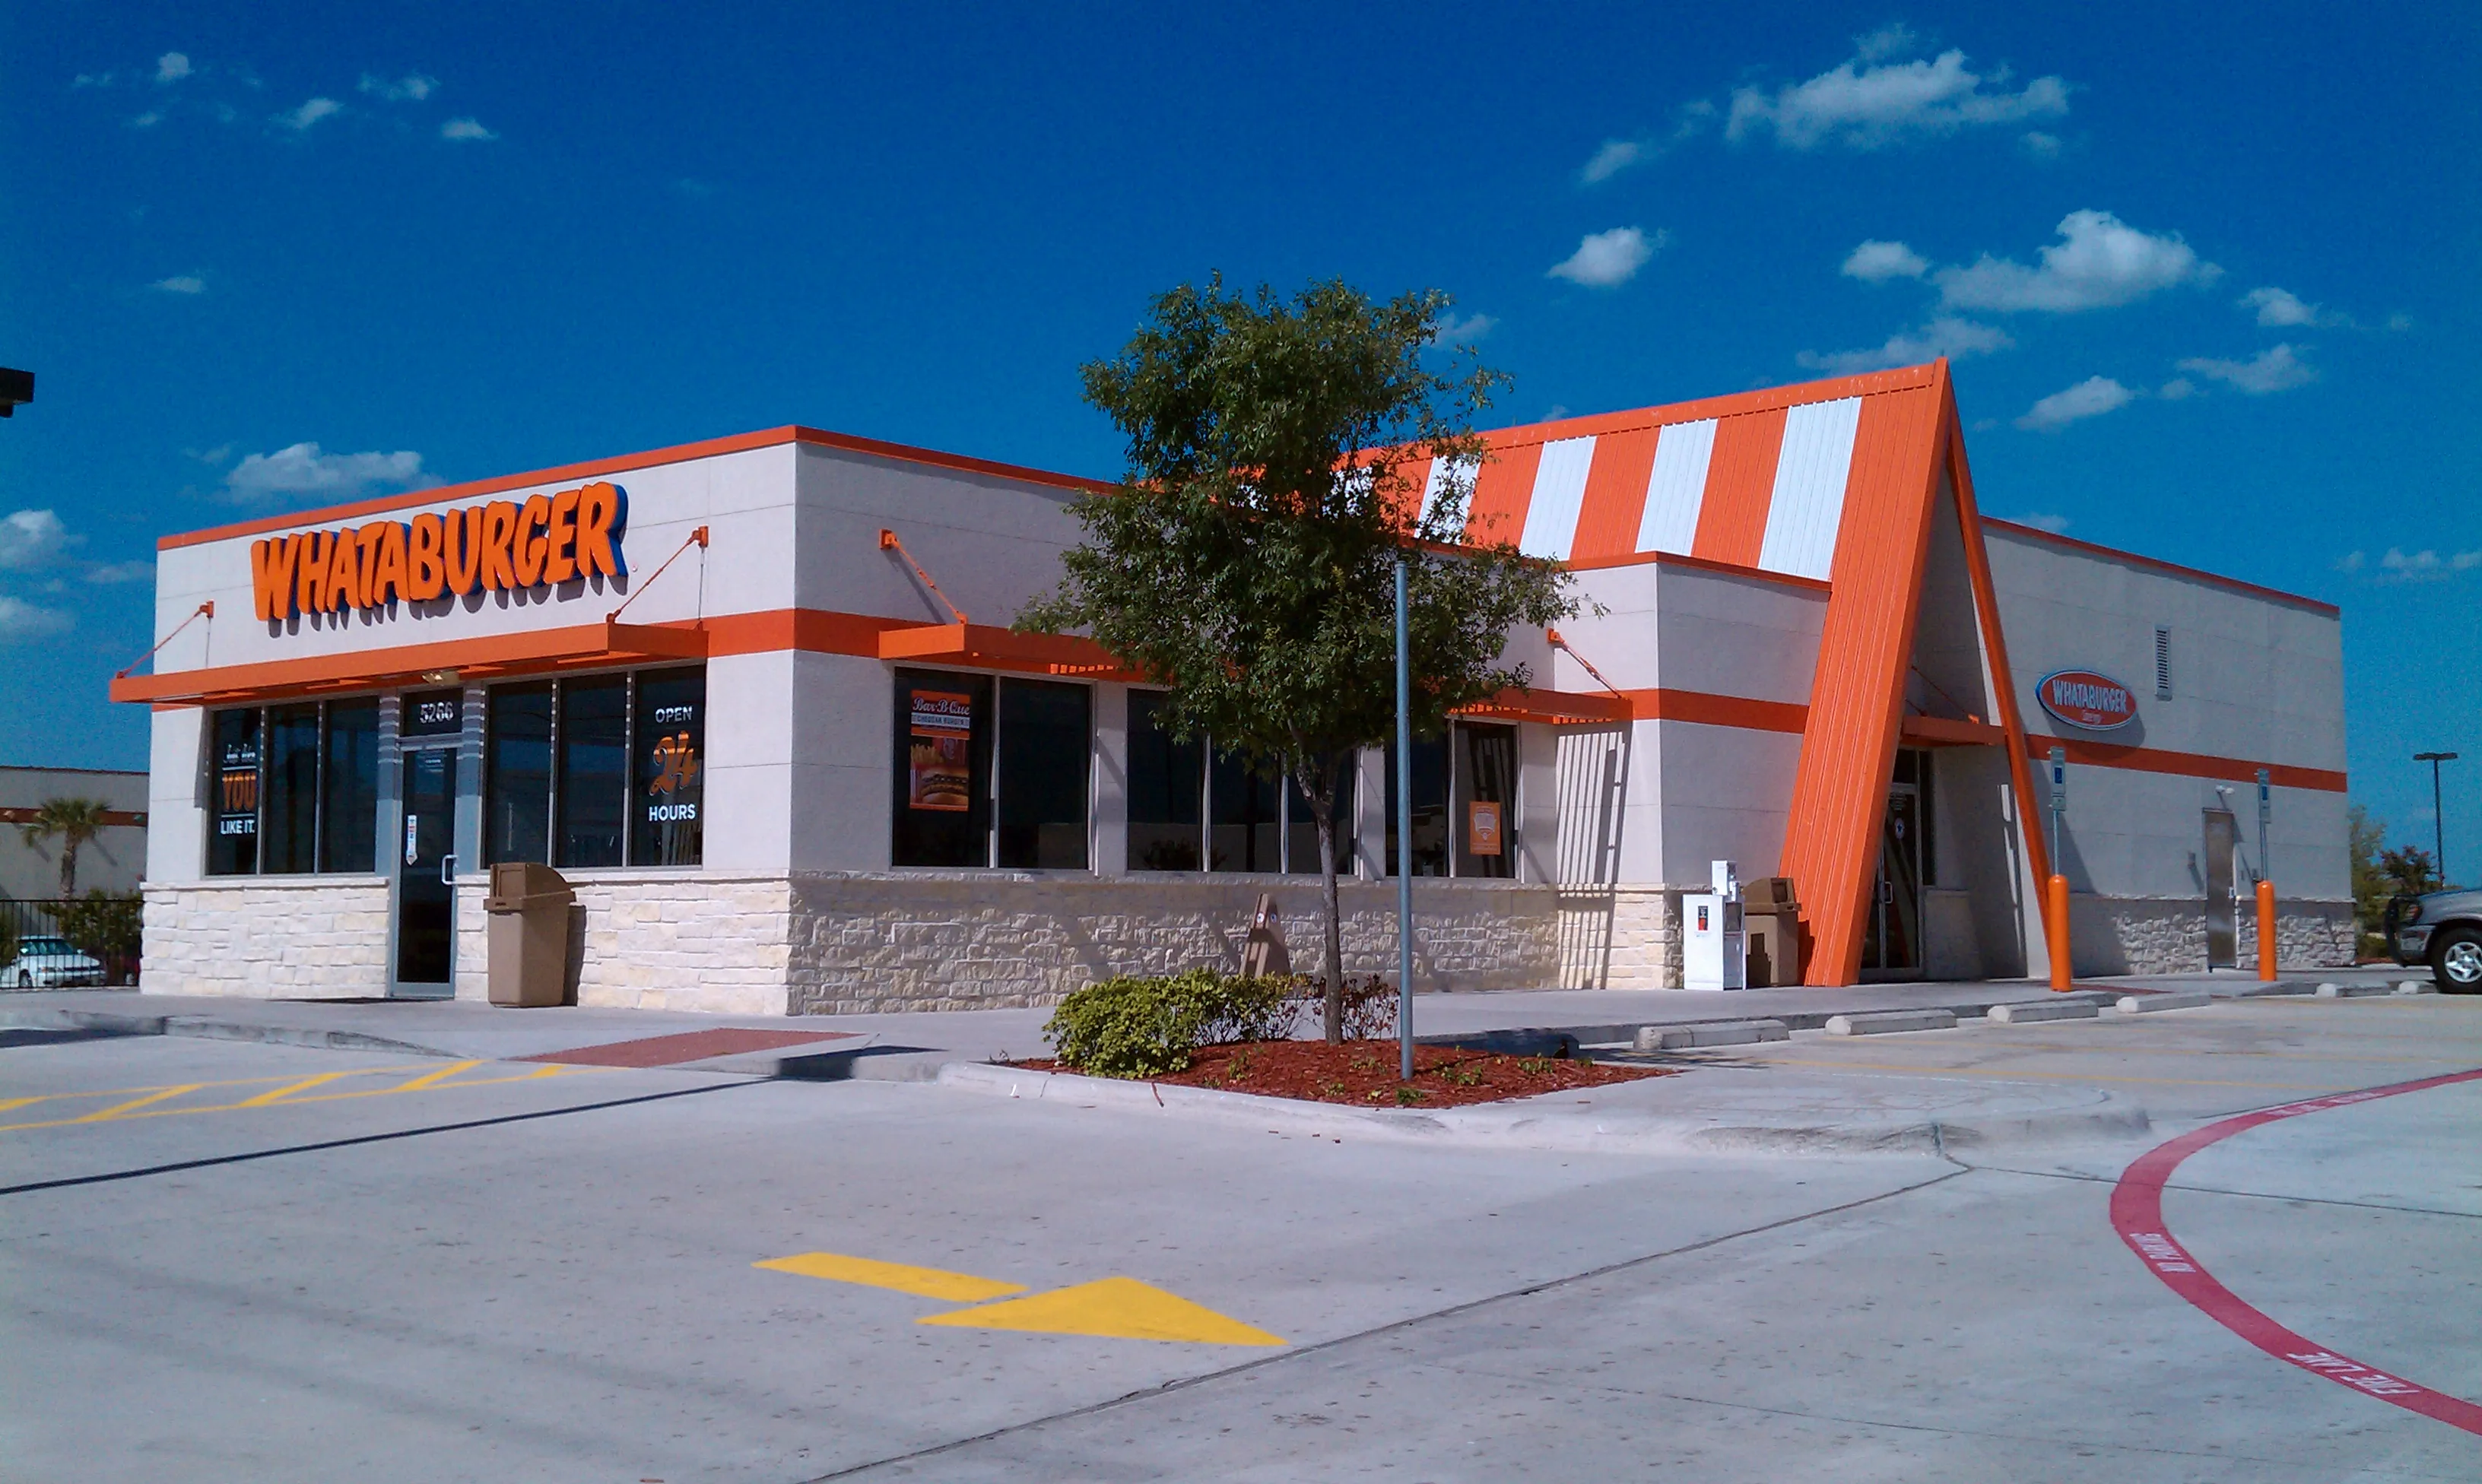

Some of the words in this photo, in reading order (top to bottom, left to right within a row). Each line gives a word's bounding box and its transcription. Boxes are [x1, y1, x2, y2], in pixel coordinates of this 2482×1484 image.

[251, 480, 624, 622] WHATABURGER
[2052, 679, 2127, 713] WHATABURGER
[420, 702, 454, 724] 5266
[655, 706, 693, 723] OPEN
[649, 730, 698, 797] 24
[222, 772, 256, 811] YOU
[649, 803, 697, 822] HOURS
[220, 820, 243, 835] LIKE
[2286, 1352, 2367, 1374] LANE
[2340, 1374, 2413, 1395] FIRE
